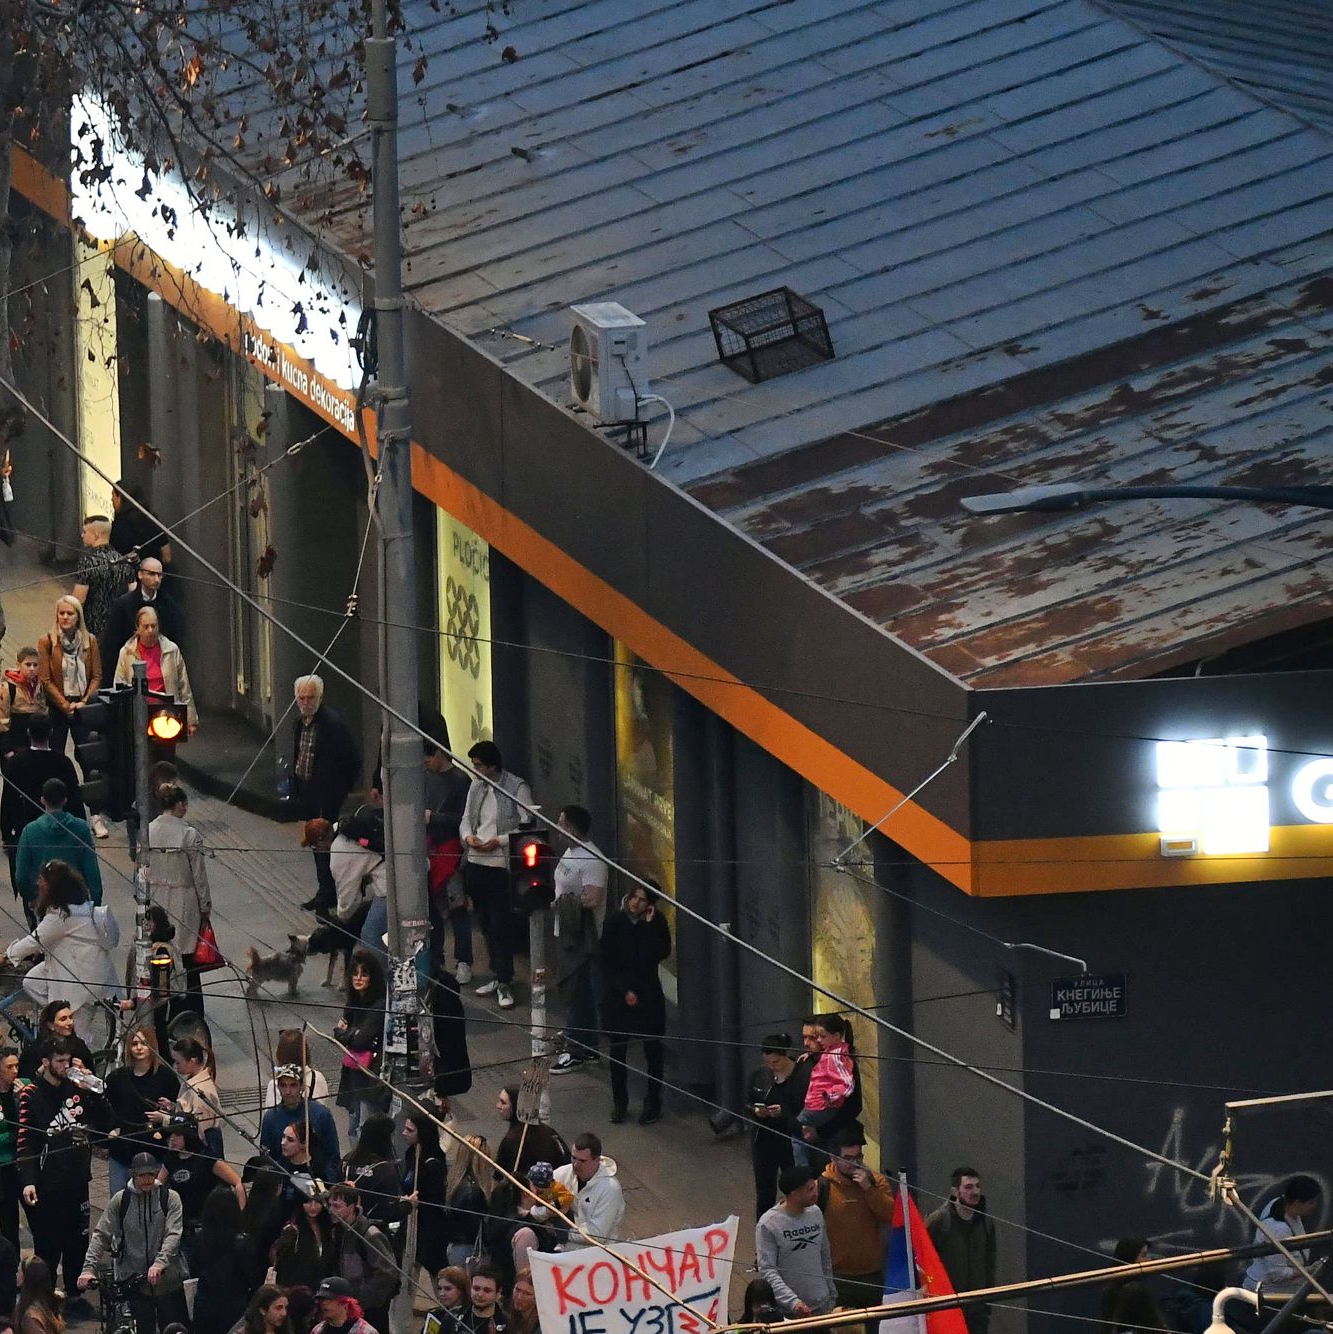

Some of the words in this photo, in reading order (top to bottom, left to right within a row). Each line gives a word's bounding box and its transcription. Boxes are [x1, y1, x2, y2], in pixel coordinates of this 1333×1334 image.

[310, 374, 355, 433] dekoracija
[1057, 987, 1122, 1002] КНЕГИЊЕ
[1060, 1000, 1118, 1015] ЉУБИЦЕ
[783, 1224, 821, 1242] Reebok
[551, 1228, 730, 1315] КОНЧАР
